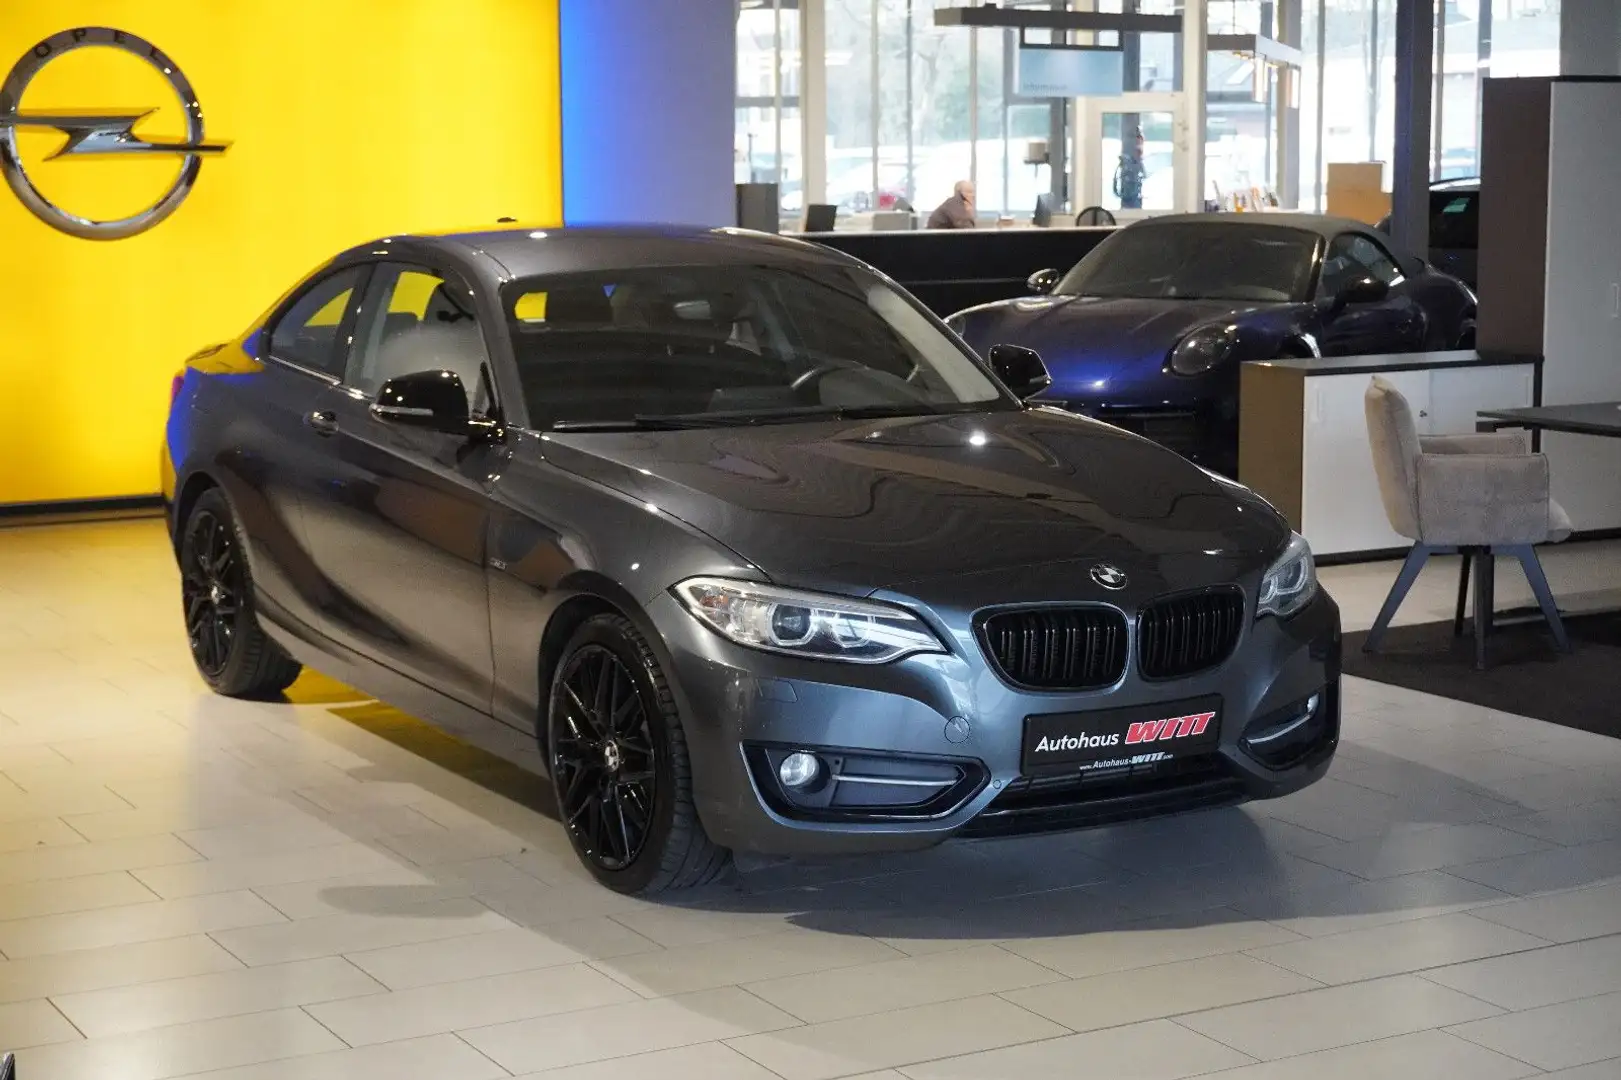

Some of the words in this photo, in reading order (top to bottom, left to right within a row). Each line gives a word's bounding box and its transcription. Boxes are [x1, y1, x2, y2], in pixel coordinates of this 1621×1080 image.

[34, 29, 164, 62] OPEL
[1035, 732, 1119, 752] Autohaus
[1124, 711, 1216, 744] WITT
